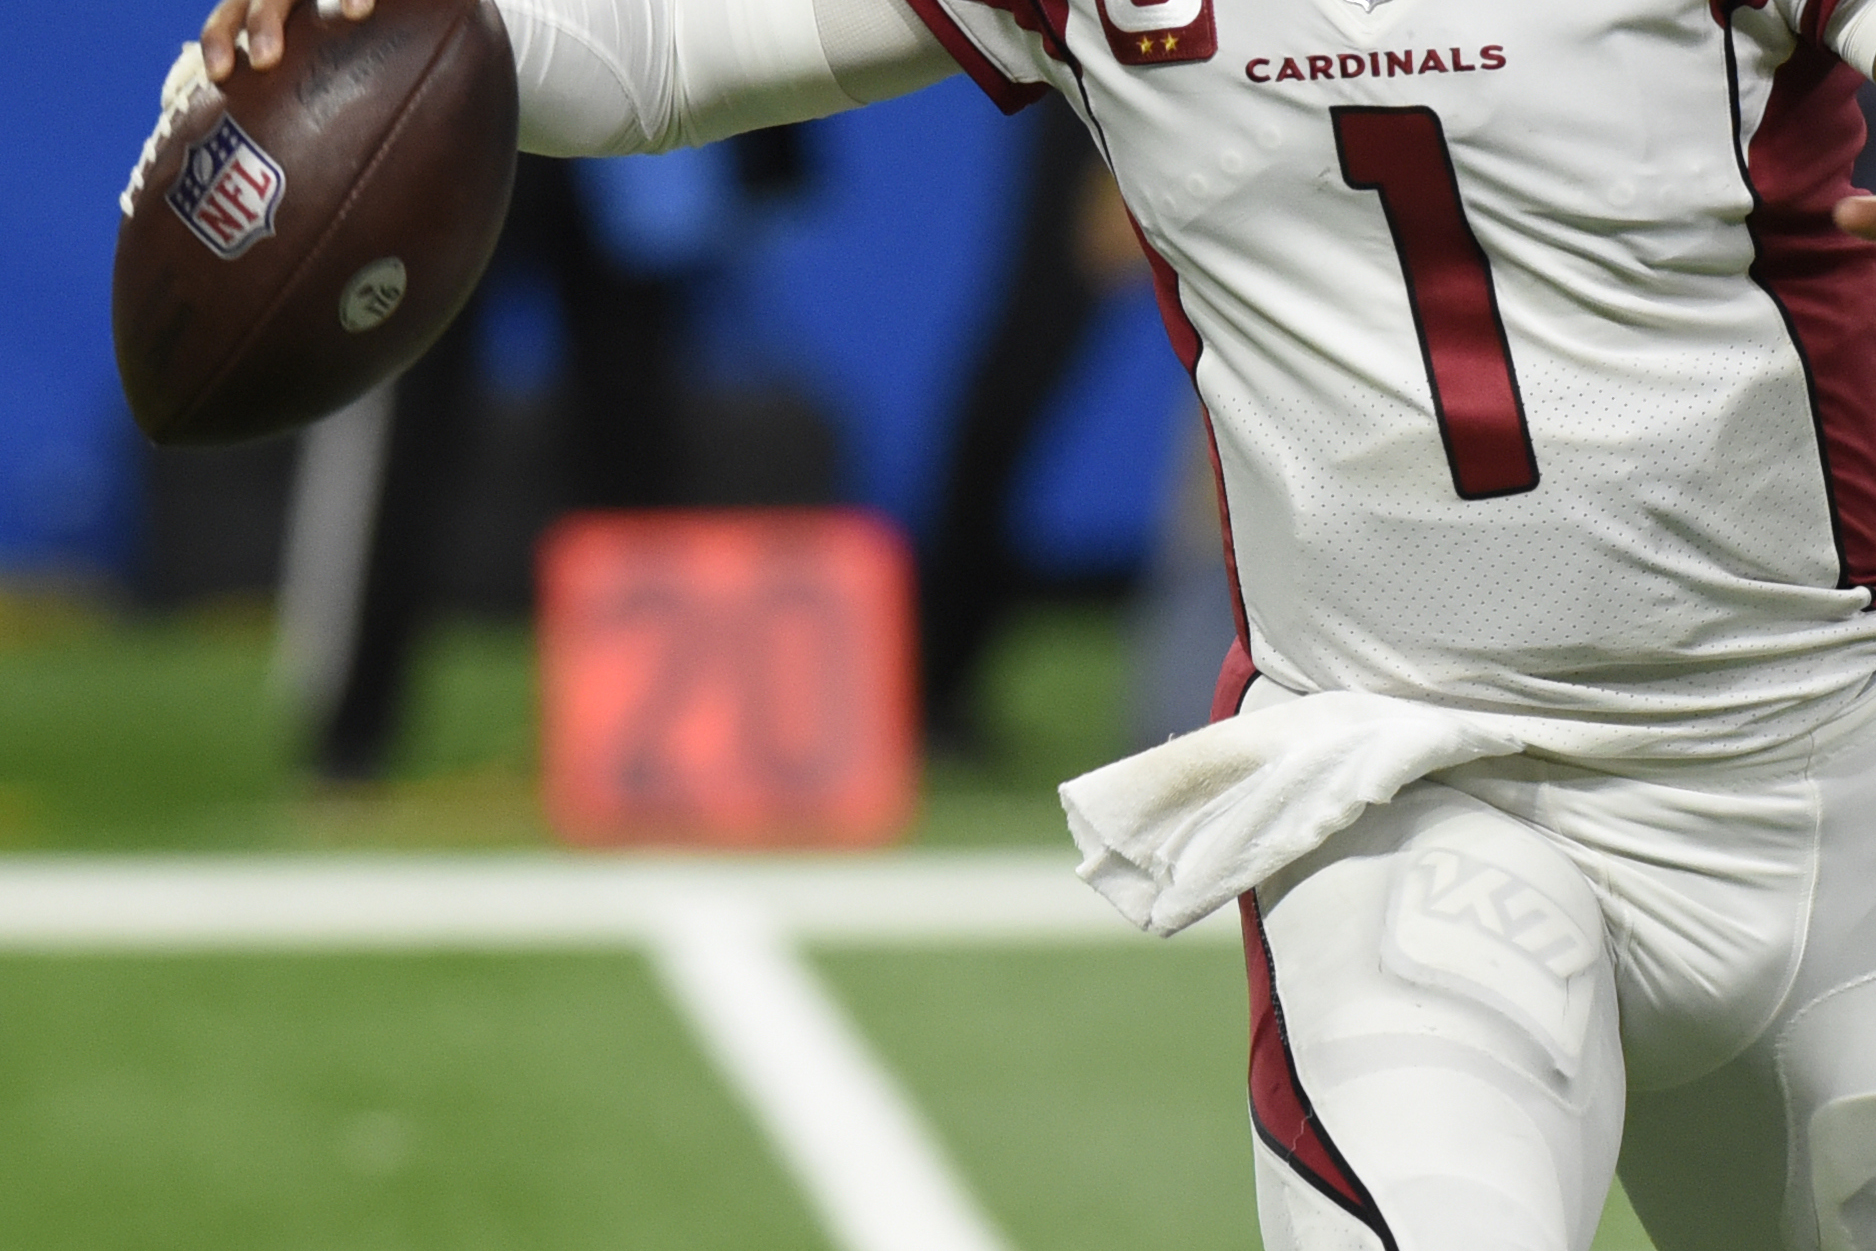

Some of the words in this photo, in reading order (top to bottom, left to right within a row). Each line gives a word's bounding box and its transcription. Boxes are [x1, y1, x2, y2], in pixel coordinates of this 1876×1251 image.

[1244, 45, 1508, 84] CARDINALS
[197, 158, 271, 245] NFL
[1328, 104, 1542, 502] 1
